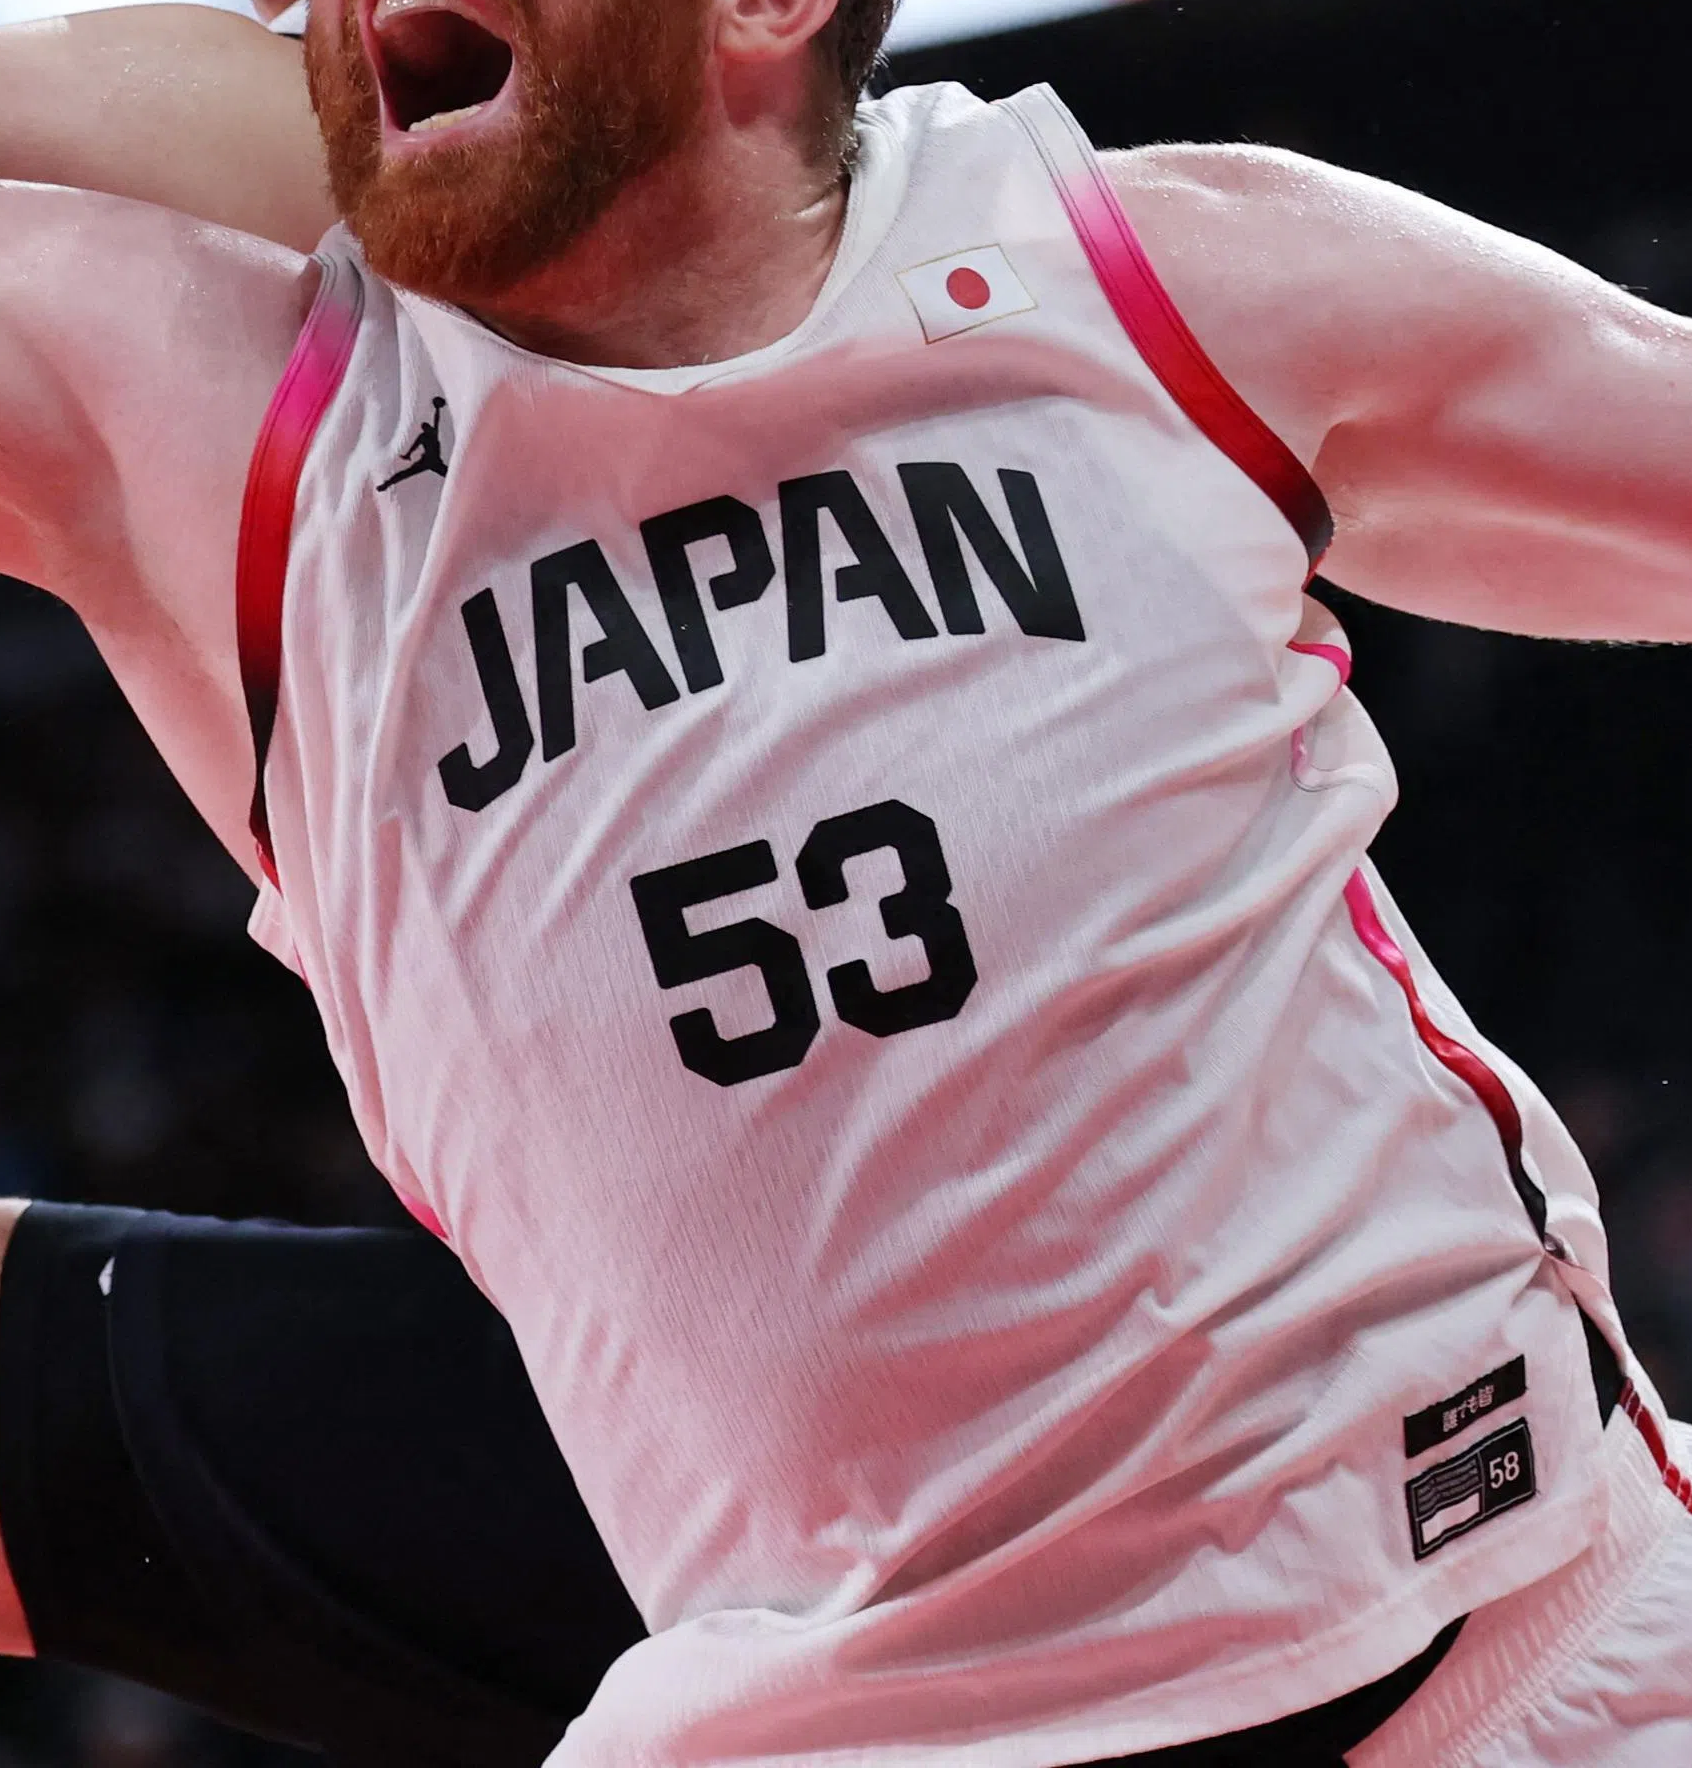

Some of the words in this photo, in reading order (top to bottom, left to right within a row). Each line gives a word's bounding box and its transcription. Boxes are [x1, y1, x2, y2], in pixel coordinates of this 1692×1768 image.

[438, 463, 1086, 813] JAPAN
[629, 799, 979, 1088] 53
[1489, 1451, 1520, 1489] 58
